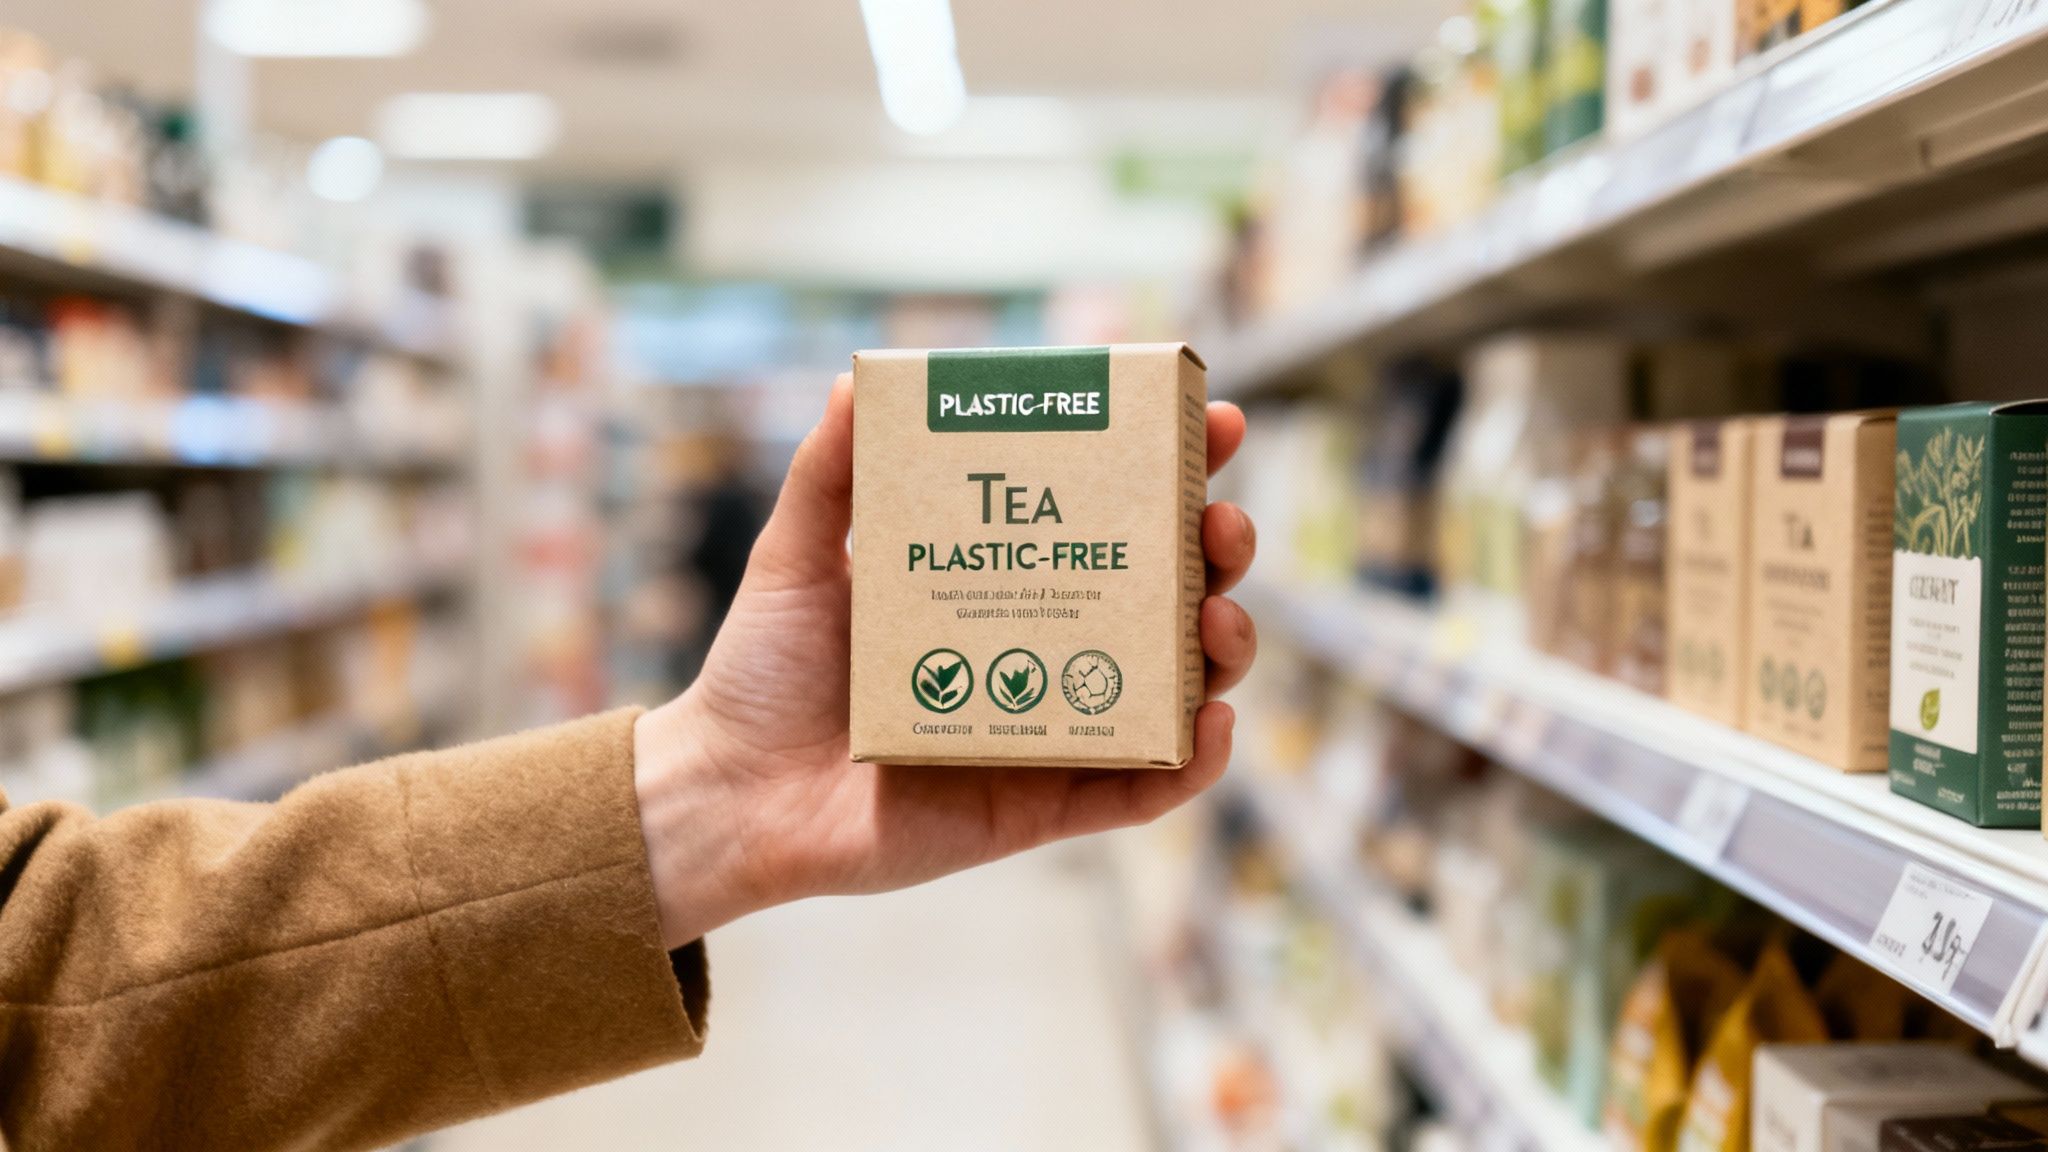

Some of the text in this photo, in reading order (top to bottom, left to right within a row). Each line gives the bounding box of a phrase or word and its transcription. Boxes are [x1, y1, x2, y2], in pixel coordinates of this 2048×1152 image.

[939, 391, 1101, 418] PLASTIC-FREE
[967, 472, 1064, 525] TEA
[908, 541, 1130, 573] PLASTIC-FREE
